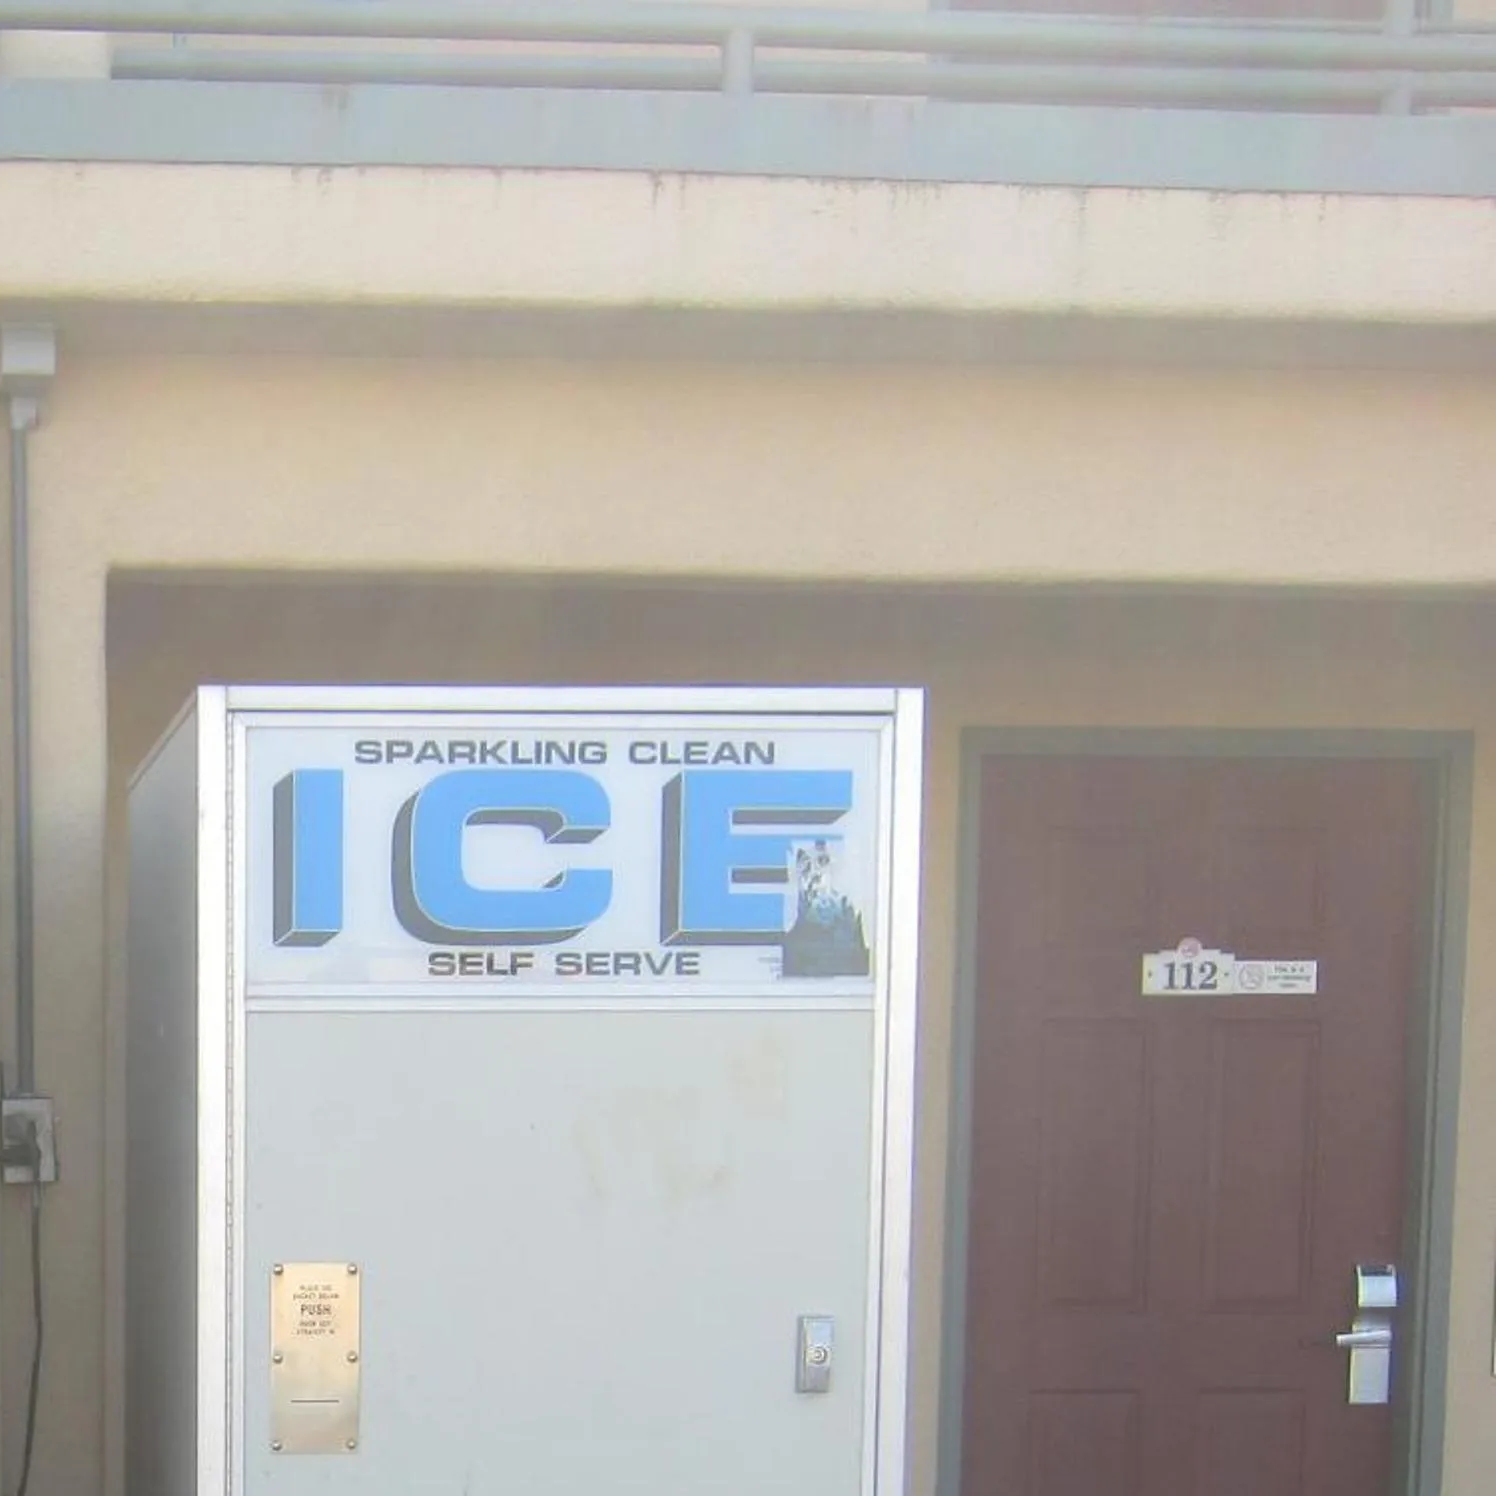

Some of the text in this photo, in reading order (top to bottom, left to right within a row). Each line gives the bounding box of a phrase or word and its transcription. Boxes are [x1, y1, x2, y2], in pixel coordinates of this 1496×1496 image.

[354, 740, 776, 766] SPARKLING CLEAN
[273, 768, 854, 947] ICE
[427, 951, 701, 978] SELF SERVE
[1163, 960, 1218, 990] 112
[300, 1303, 332, 1316] PUSH
